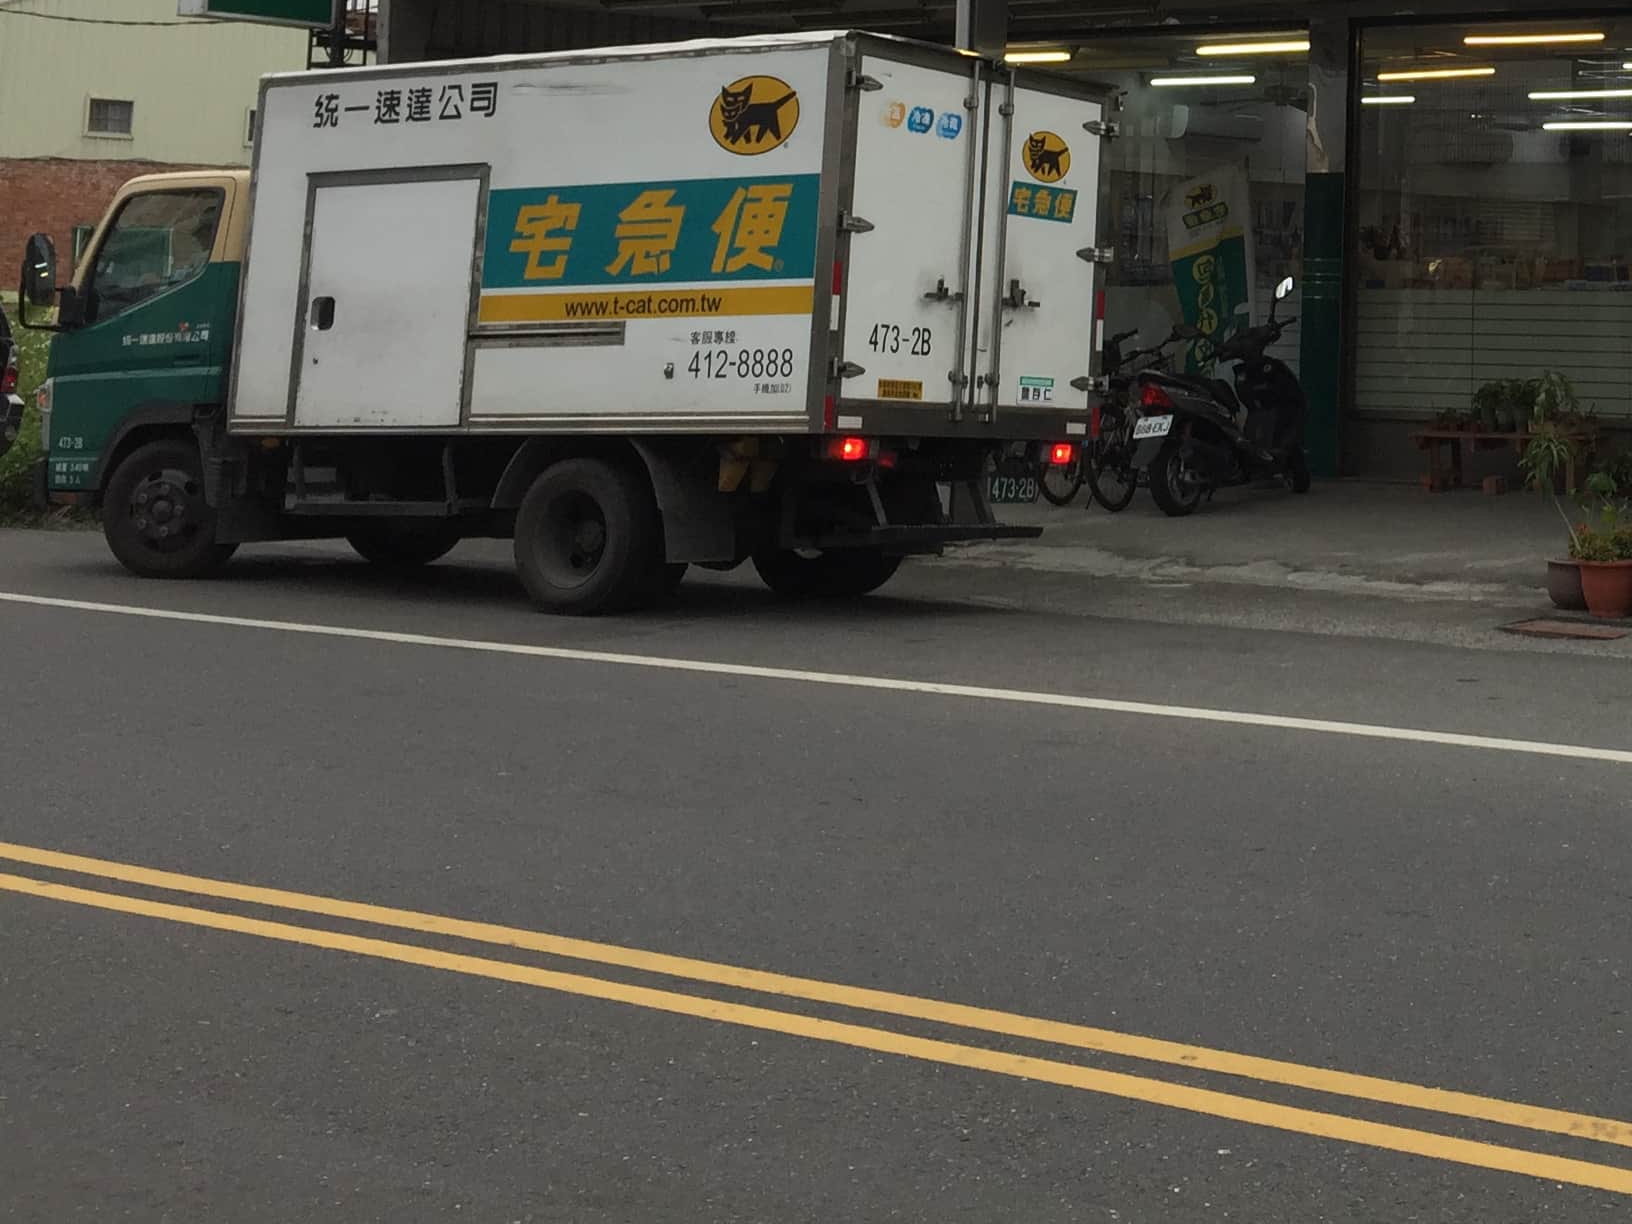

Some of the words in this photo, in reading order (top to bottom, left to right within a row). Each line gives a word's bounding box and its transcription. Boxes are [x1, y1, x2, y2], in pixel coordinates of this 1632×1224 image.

[312, 81, 499, 129] 統一速達公司
[1012, 187, 1074, 220] 宅急便
[508, 182, 794, 280] 宅急便
[564, 293, 722, 317] www.t-cat.com.tw
[690, 330, 737, 345] 客服專線
[868, 322, 932, 357] 473-2B
[688, 348, 794, 378] 412-8888
